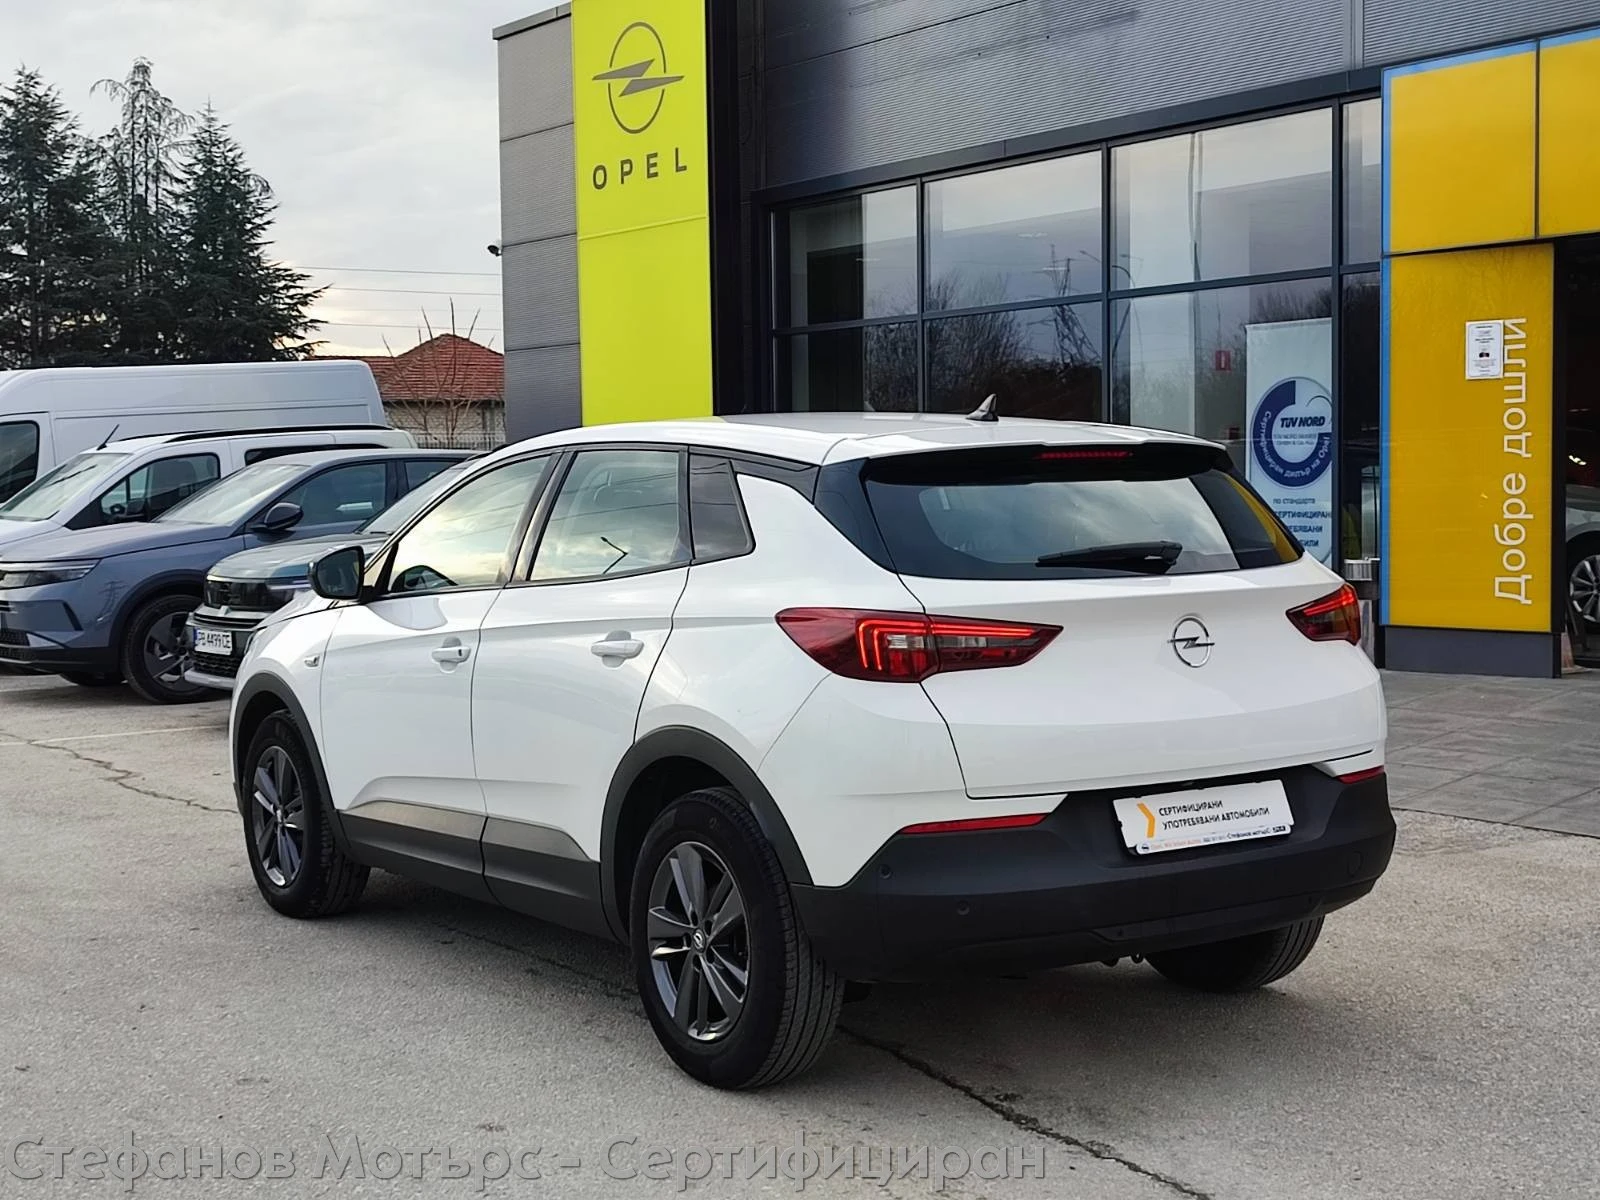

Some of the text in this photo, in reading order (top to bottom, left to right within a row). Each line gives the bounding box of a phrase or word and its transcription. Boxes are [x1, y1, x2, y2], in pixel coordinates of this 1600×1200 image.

[593, 147, 688, 190] OPEL
[1298, 415, 1326, 427] NORD
[1318, 436, 1331, 458] Opel
[1494, 317, 1534, 605] Добре дошли
[1158, 800, 1224, 817] СЕРТИФИЦИРАНИ
[1162, 807, 1271, 831] УПОТРЕБЯВАНИ АВТОМОБИЛИ
